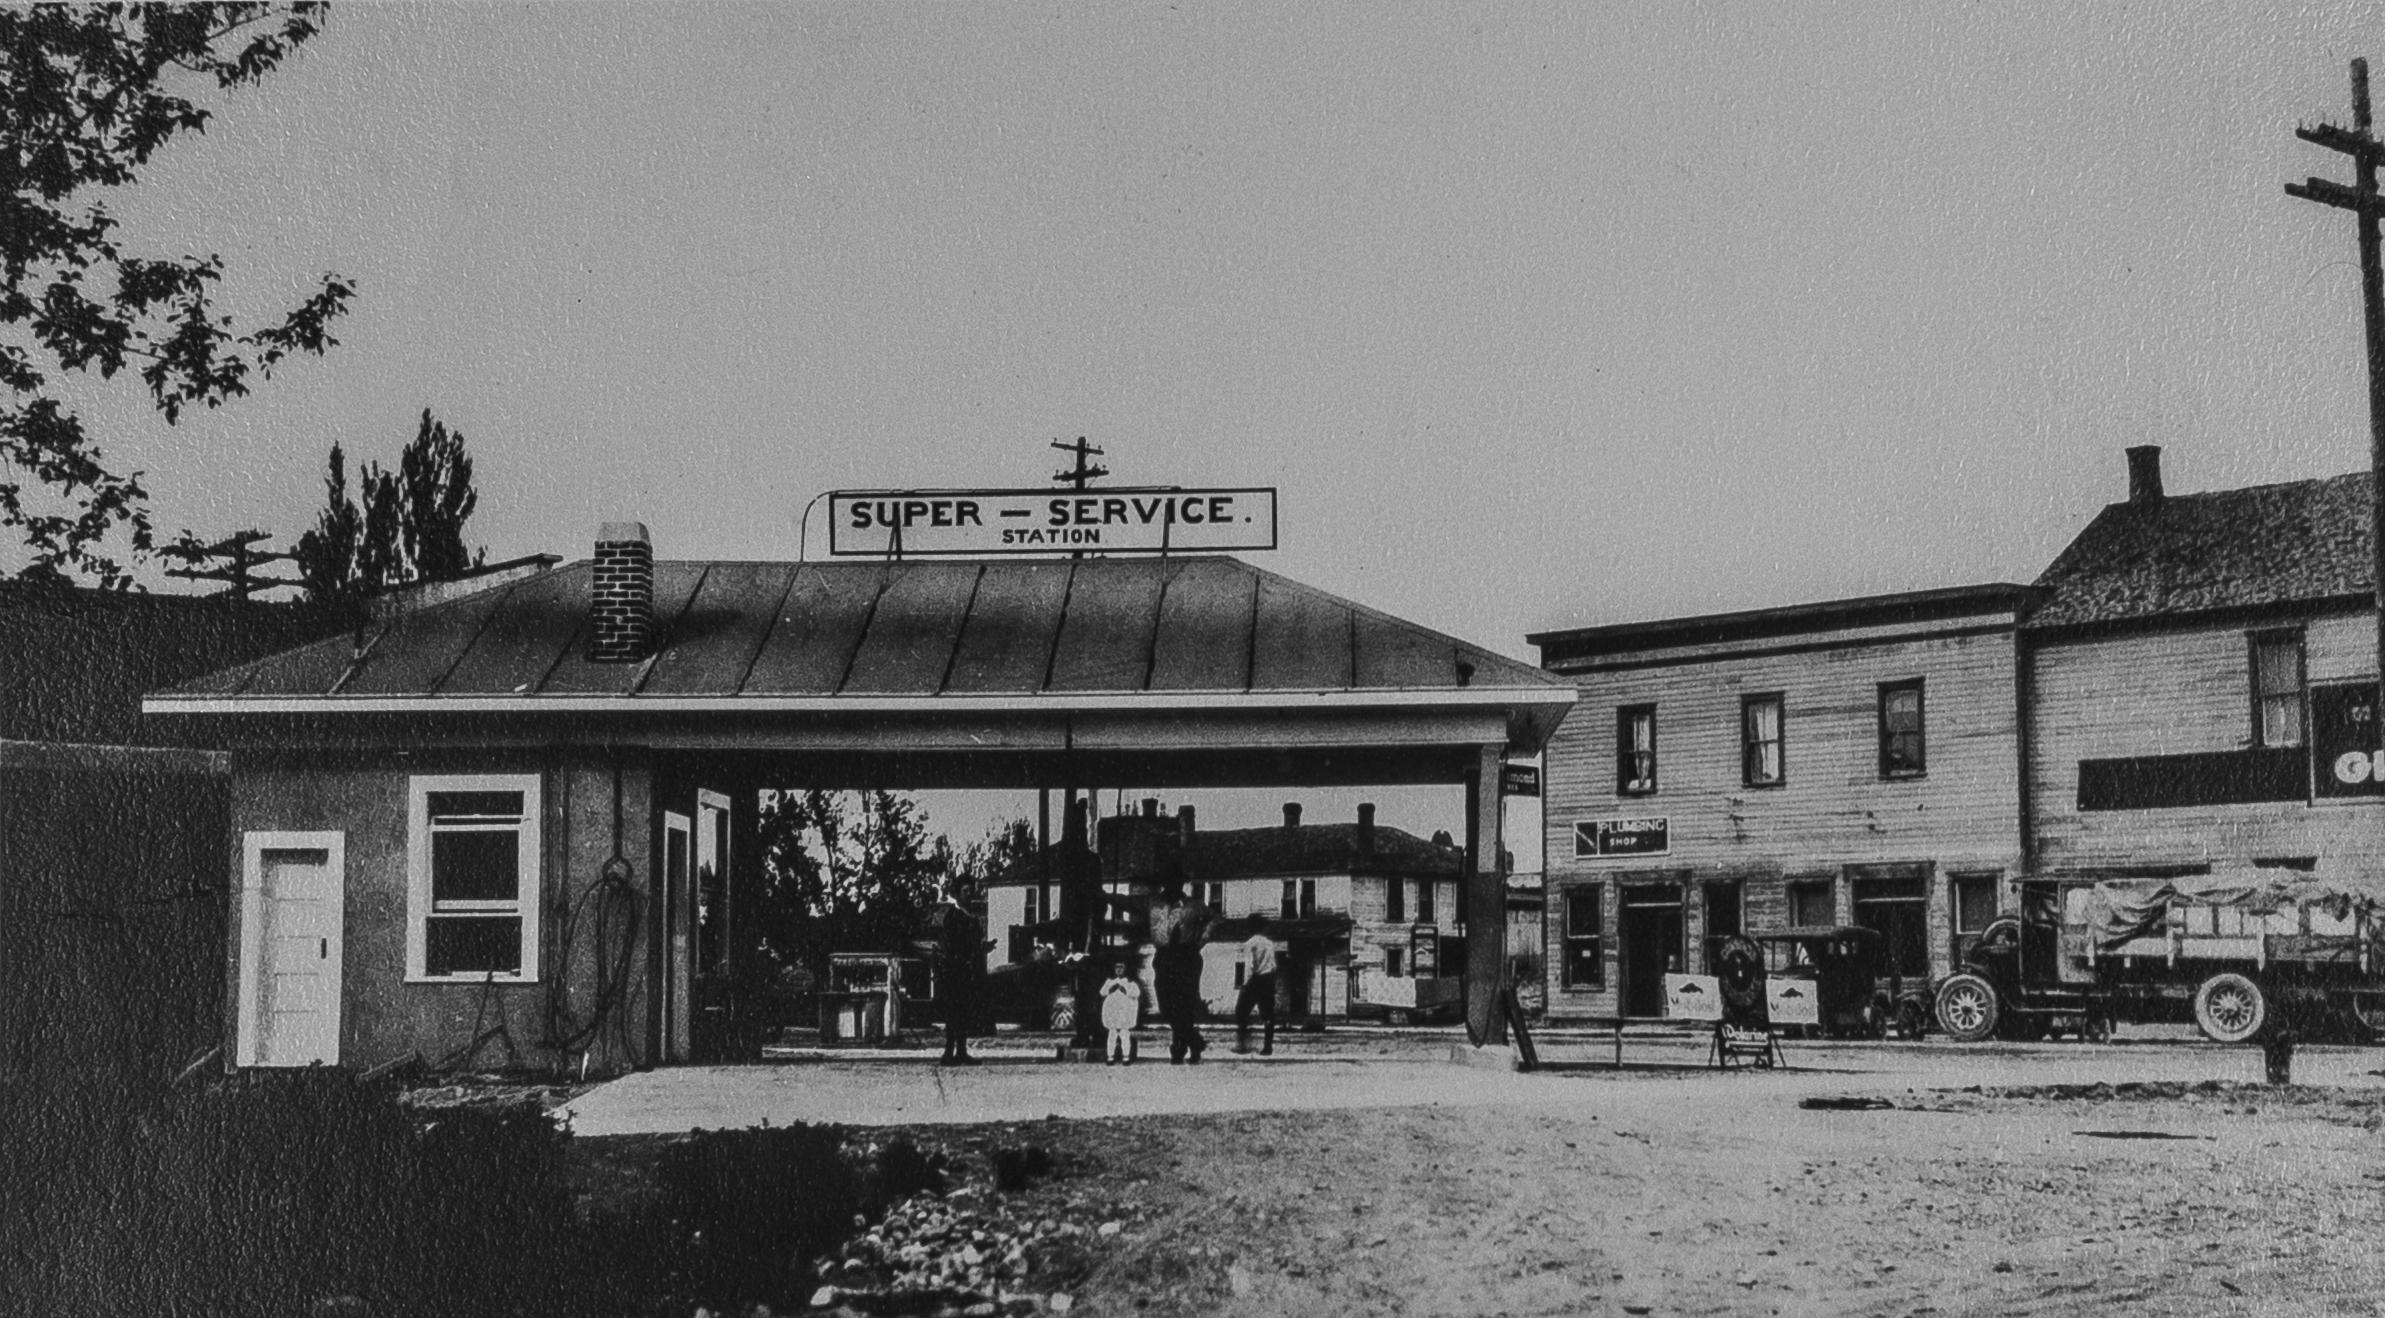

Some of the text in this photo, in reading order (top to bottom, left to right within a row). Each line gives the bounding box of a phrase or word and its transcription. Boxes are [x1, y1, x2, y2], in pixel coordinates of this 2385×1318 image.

[850, 500, 983, 528] SUPER
[1002, 528, 1100, 544] STATION
[1599, 819, 1664, 834] PLUMBING
[1609, 837, 1637, 847] SHOP
